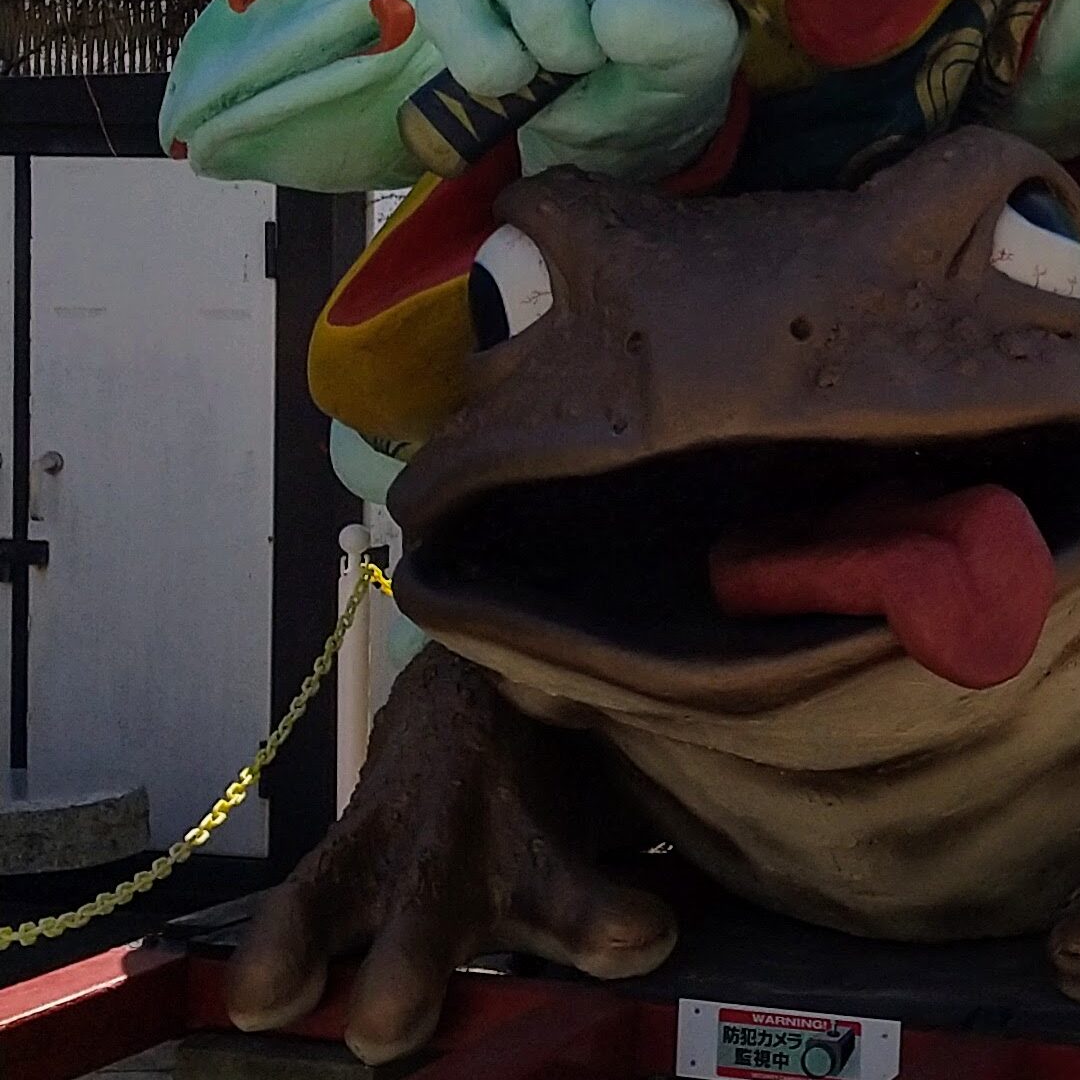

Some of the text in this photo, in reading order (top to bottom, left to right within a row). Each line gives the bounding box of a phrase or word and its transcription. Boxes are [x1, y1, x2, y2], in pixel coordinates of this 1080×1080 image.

[752, 1013, 828, 1031] WARNING!
[722, 1025, 803, 1050] 防犯カメラ
[734, 1047, 790, 1070] 監視中
